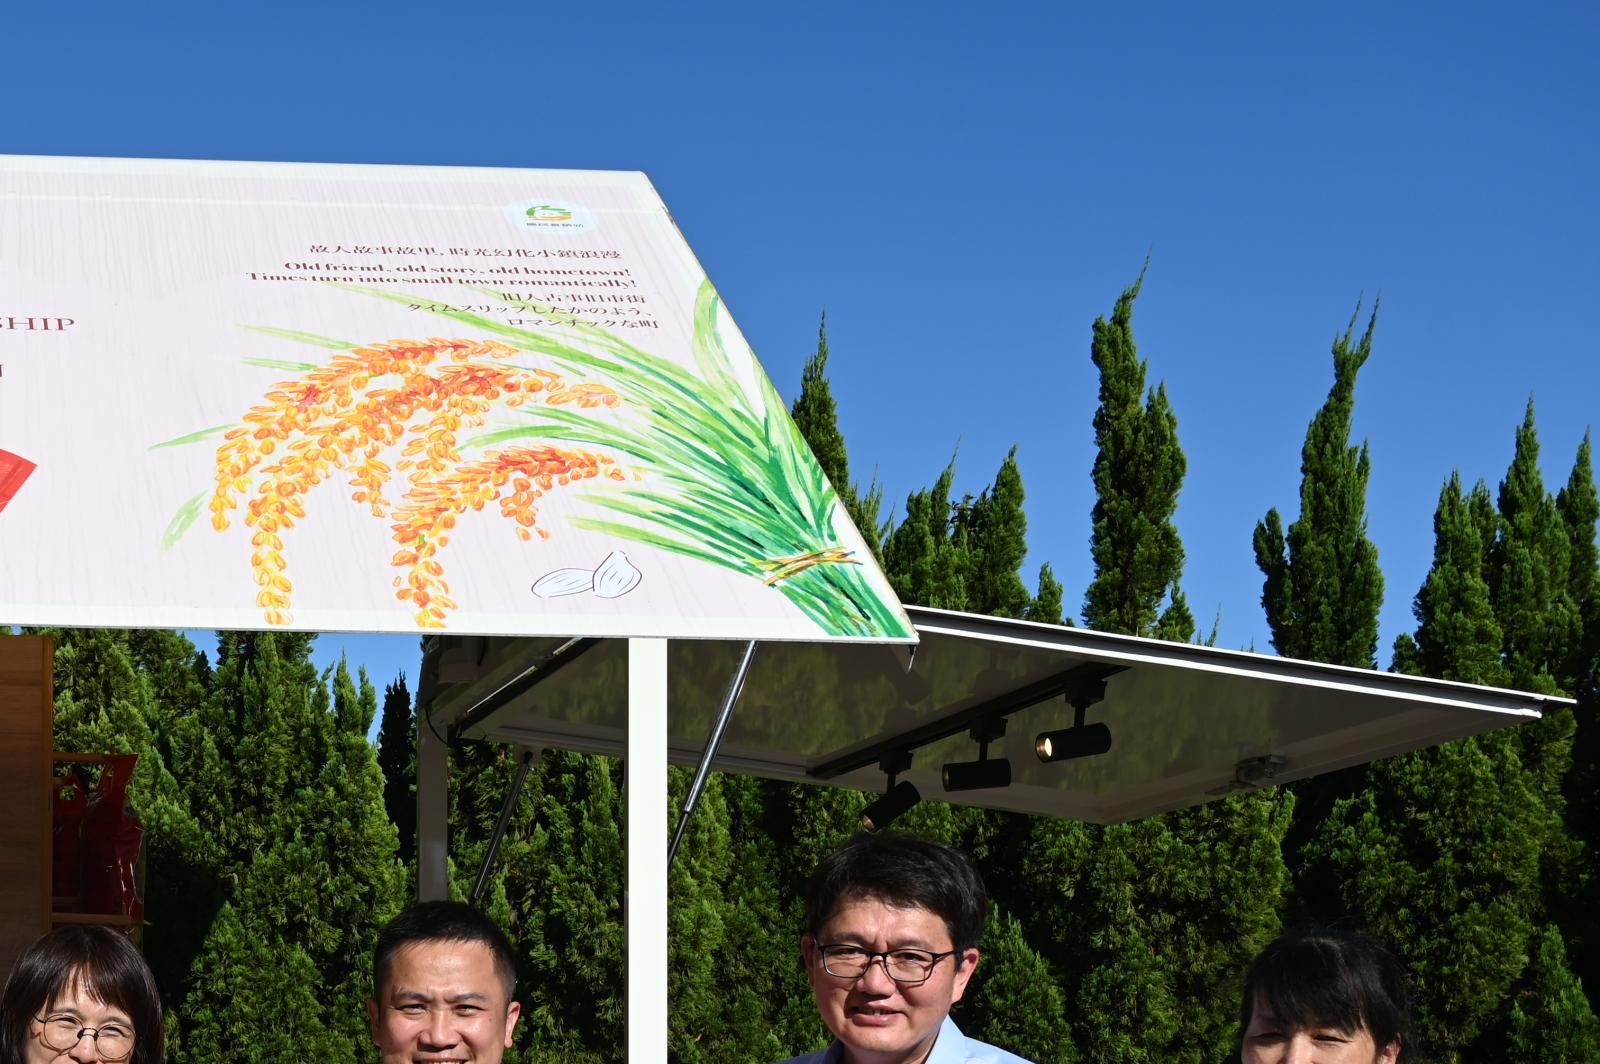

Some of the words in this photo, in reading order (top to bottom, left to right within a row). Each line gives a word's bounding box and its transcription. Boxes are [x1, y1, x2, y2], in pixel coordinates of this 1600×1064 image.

[284, 262, 320, 271] Old
[325, 263, 393, 273] friend,
[396, 265, 426, 274] old
[431, 266, 484, 277] story,
[488, 267, 519, 276] old
[523, 267, 631, 278] hometown!
[245, 272, 308, 283] Times
[311, 275, 355, 283] turn
[358, 274, 399, 284] into
[401, 275, 455, 285] small
[458, 277, 504, 286] town
[508, 278, 638, 290] romantically!
